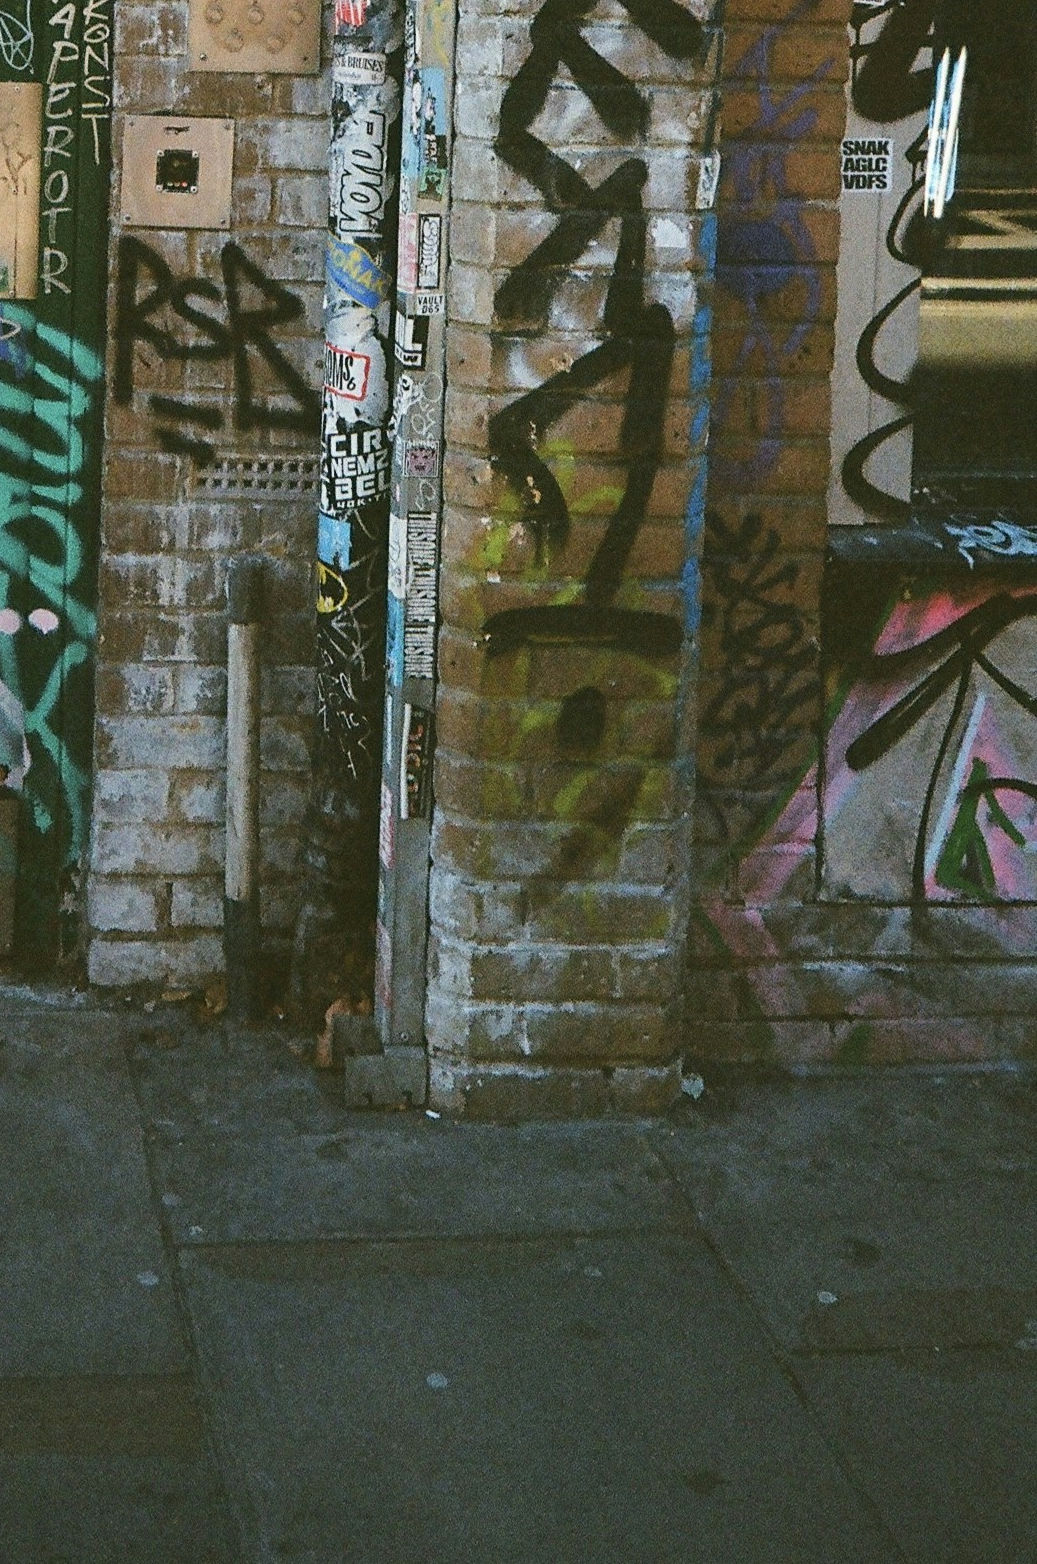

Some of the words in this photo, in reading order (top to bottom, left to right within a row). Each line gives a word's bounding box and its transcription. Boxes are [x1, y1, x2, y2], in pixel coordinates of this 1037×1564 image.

[842, 139, 890, 156] SNAK
[842, 156, 887, 173] AGLC
[842, 173, 887, 190] VDFS
[416, 295, 443, 307] VAULT
[330, 429, 382, 458] CIR
[331, 449, 389, 478] NEMZ
[334, 469, 389, 501] BEL
